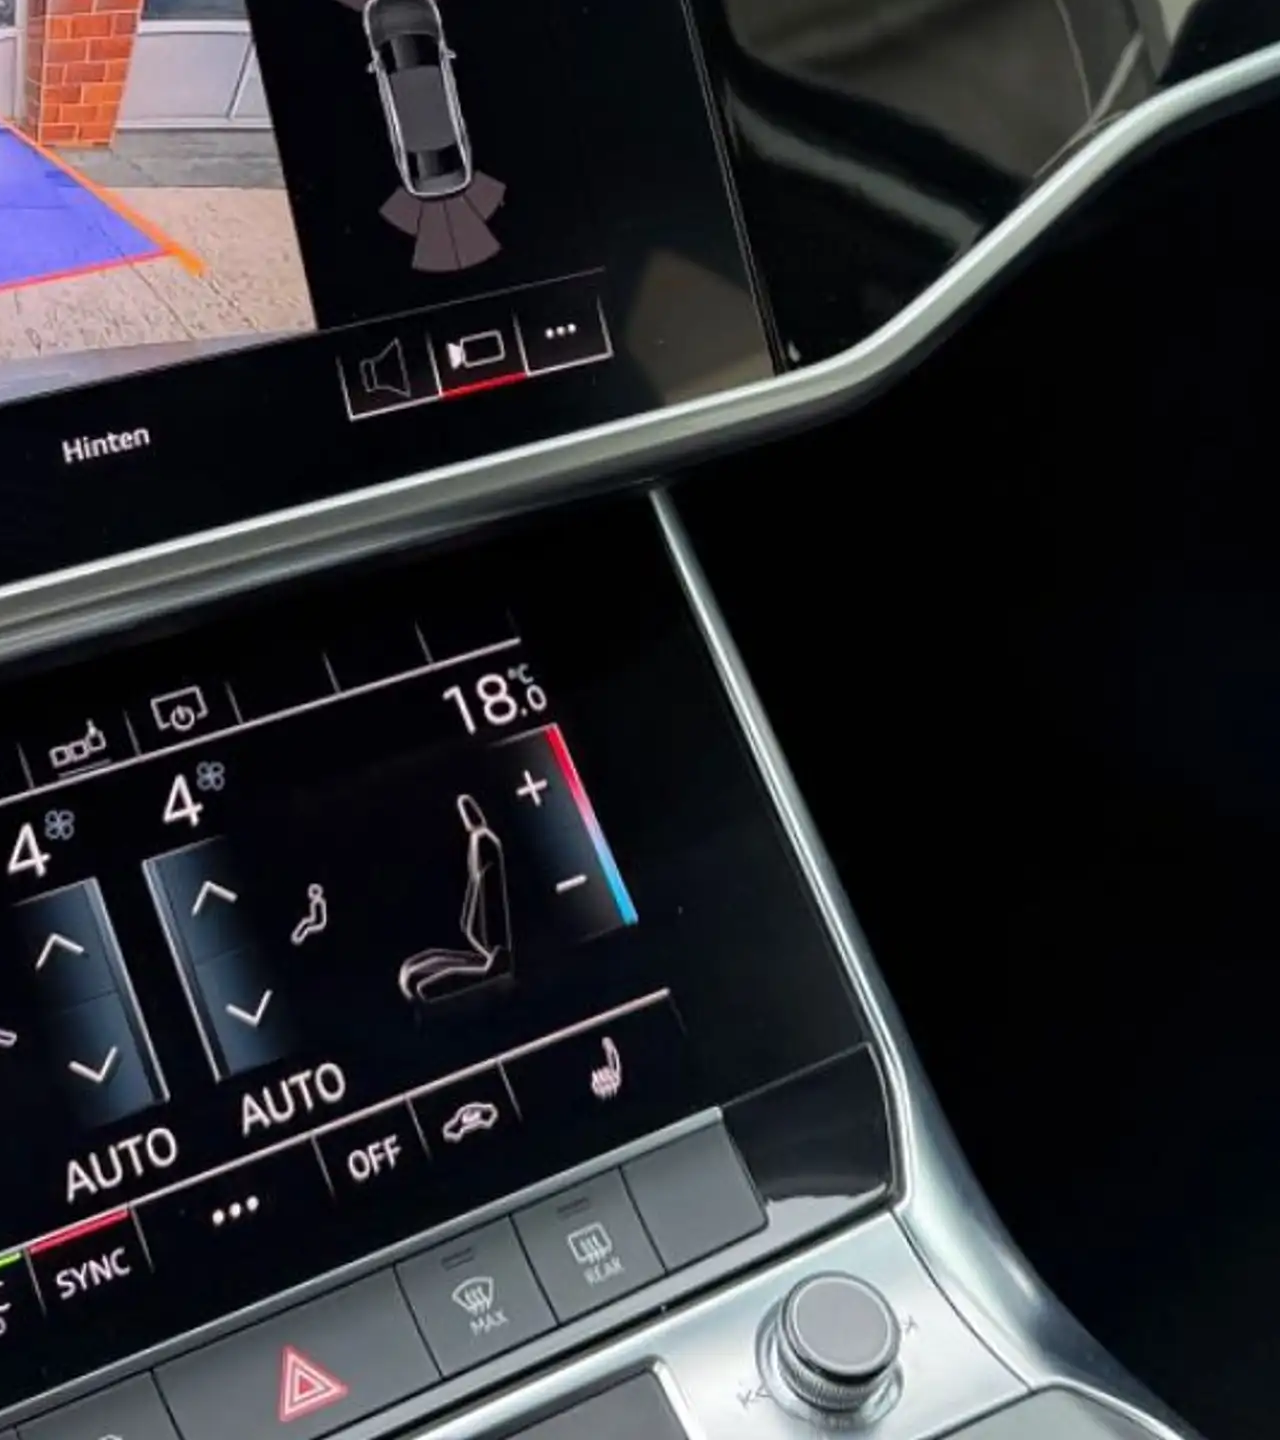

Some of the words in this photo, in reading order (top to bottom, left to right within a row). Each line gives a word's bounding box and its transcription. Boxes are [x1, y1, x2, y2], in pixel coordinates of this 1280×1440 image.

[62, 427, 151, 465] Hinten
[163, 773, 204, 827] 4
[7, 821, 51, 877] 4
[241, 1061, 347, 1135] AUTO
[66, 1126, 179, 1202] AUTO
[347, 1133, 402, 1182] OFF
[55, 1246, 132, 1301] SYNC
